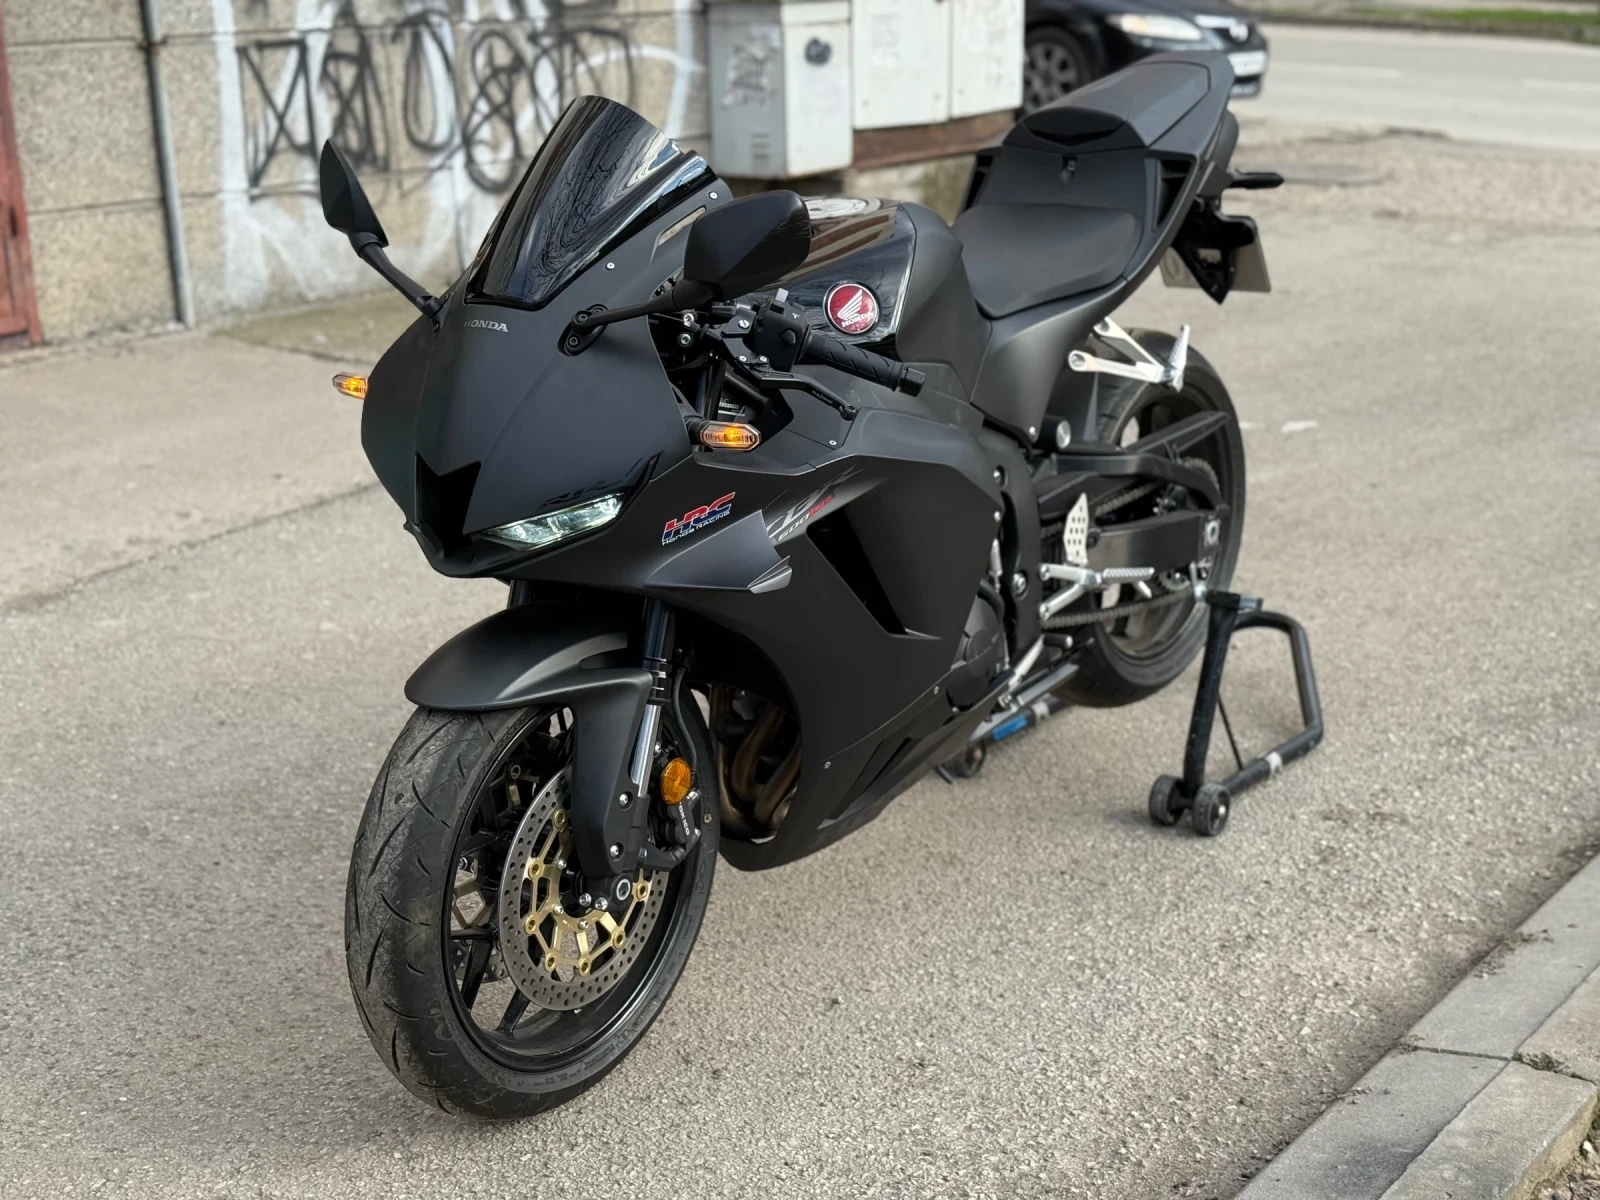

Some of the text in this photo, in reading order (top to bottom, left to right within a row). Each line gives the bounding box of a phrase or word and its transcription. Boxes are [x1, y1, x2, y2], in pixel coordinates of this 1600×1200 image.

[463, 319, 509, 333] HONDA
[840, 311, 875, 328] HONDA
[661, 491, 736, 542] HRC
[678, 801, 690, 836] OKICO
